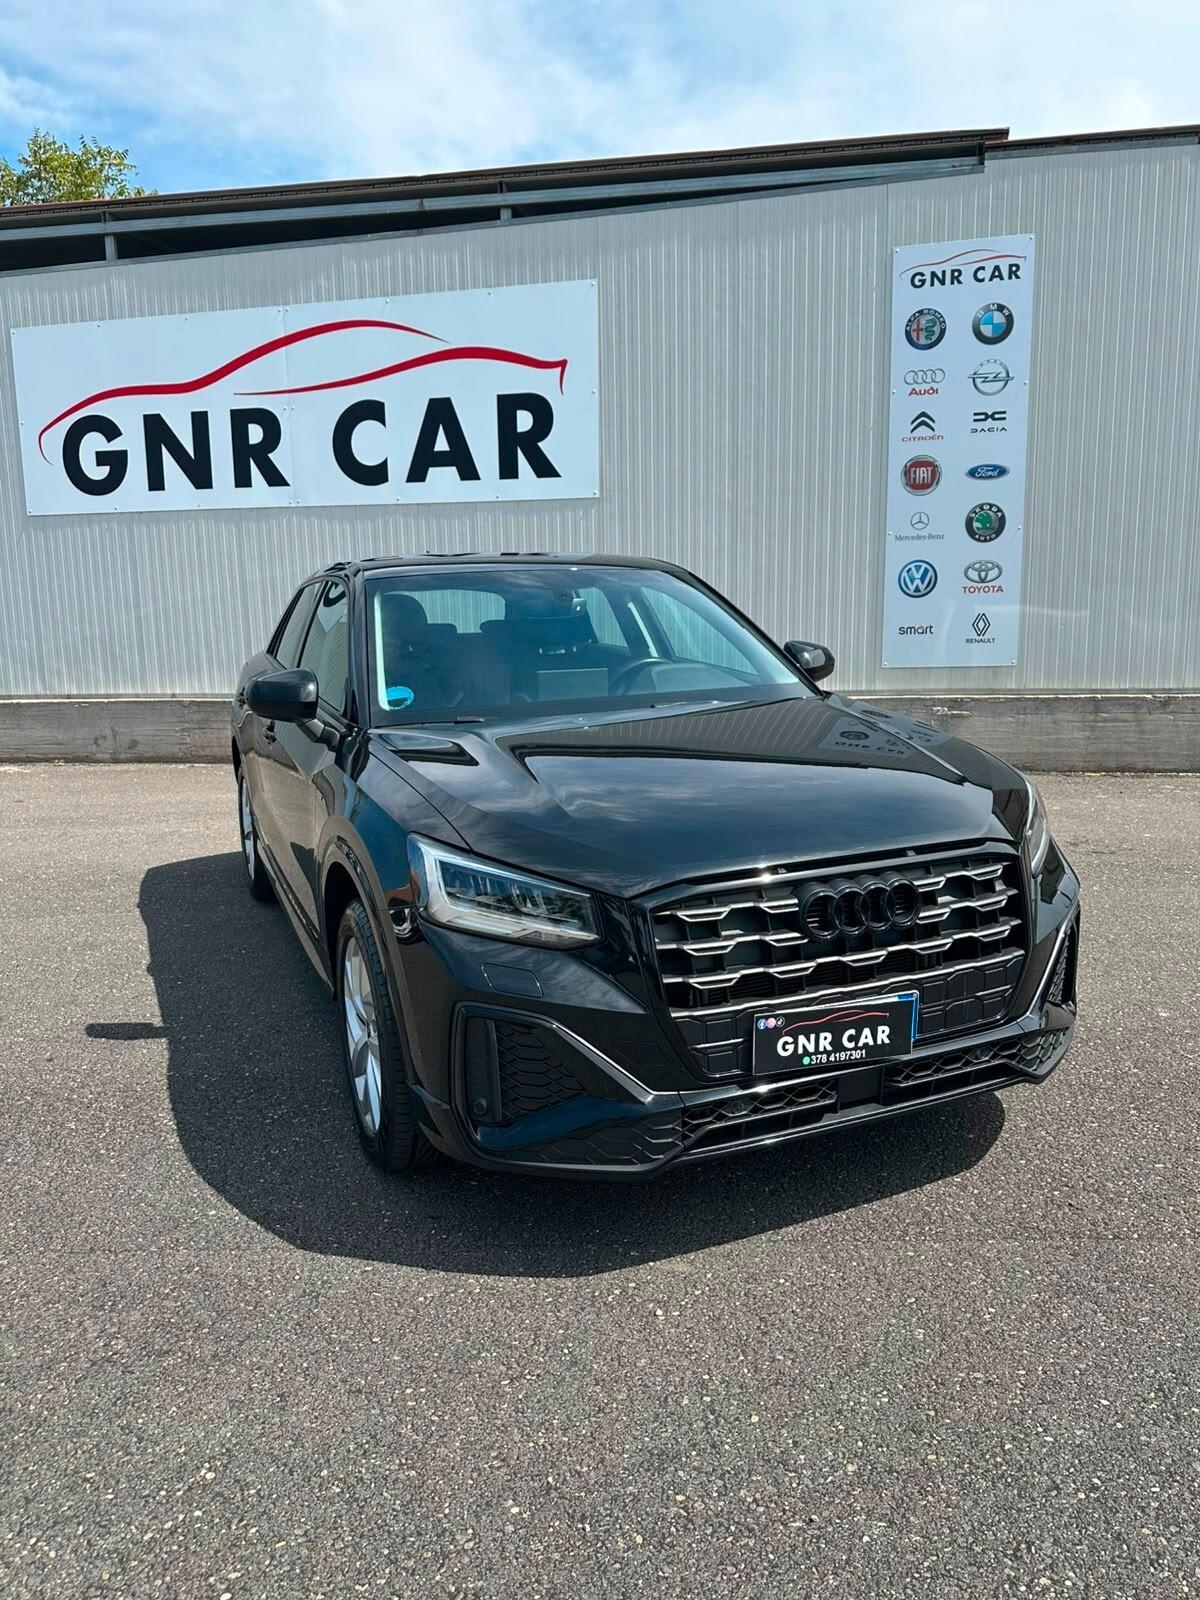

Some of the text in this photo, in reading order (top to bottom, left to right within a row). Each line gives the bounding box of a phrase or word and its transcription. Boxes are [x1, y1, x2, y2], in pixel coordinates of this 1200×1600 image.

[910, 263, 1021, 289] GNR CAR
[976, 303, 1011, 318] BMW
[906, 309, 946, 331] ALFA ROMEO
[908, 387, 939, 397] Audi
[970, 426, 1007, 434] DACIA
[62, 392, 563, 496] GNR CAR
[910, 466, 933, 485] FIAT
[975, 466, 1000, 478] Ford
[894, 532, 945, 542] Mercedes-Benz
[974, 533, 997, 541] AUTO
[962, 585, 1004, 594] TOYOTA
[898, 624, 934, 635] smart
[776, 1026, 891, 1057] GNR CAR
[810, 1050, 866, 1065] 378 4197301
